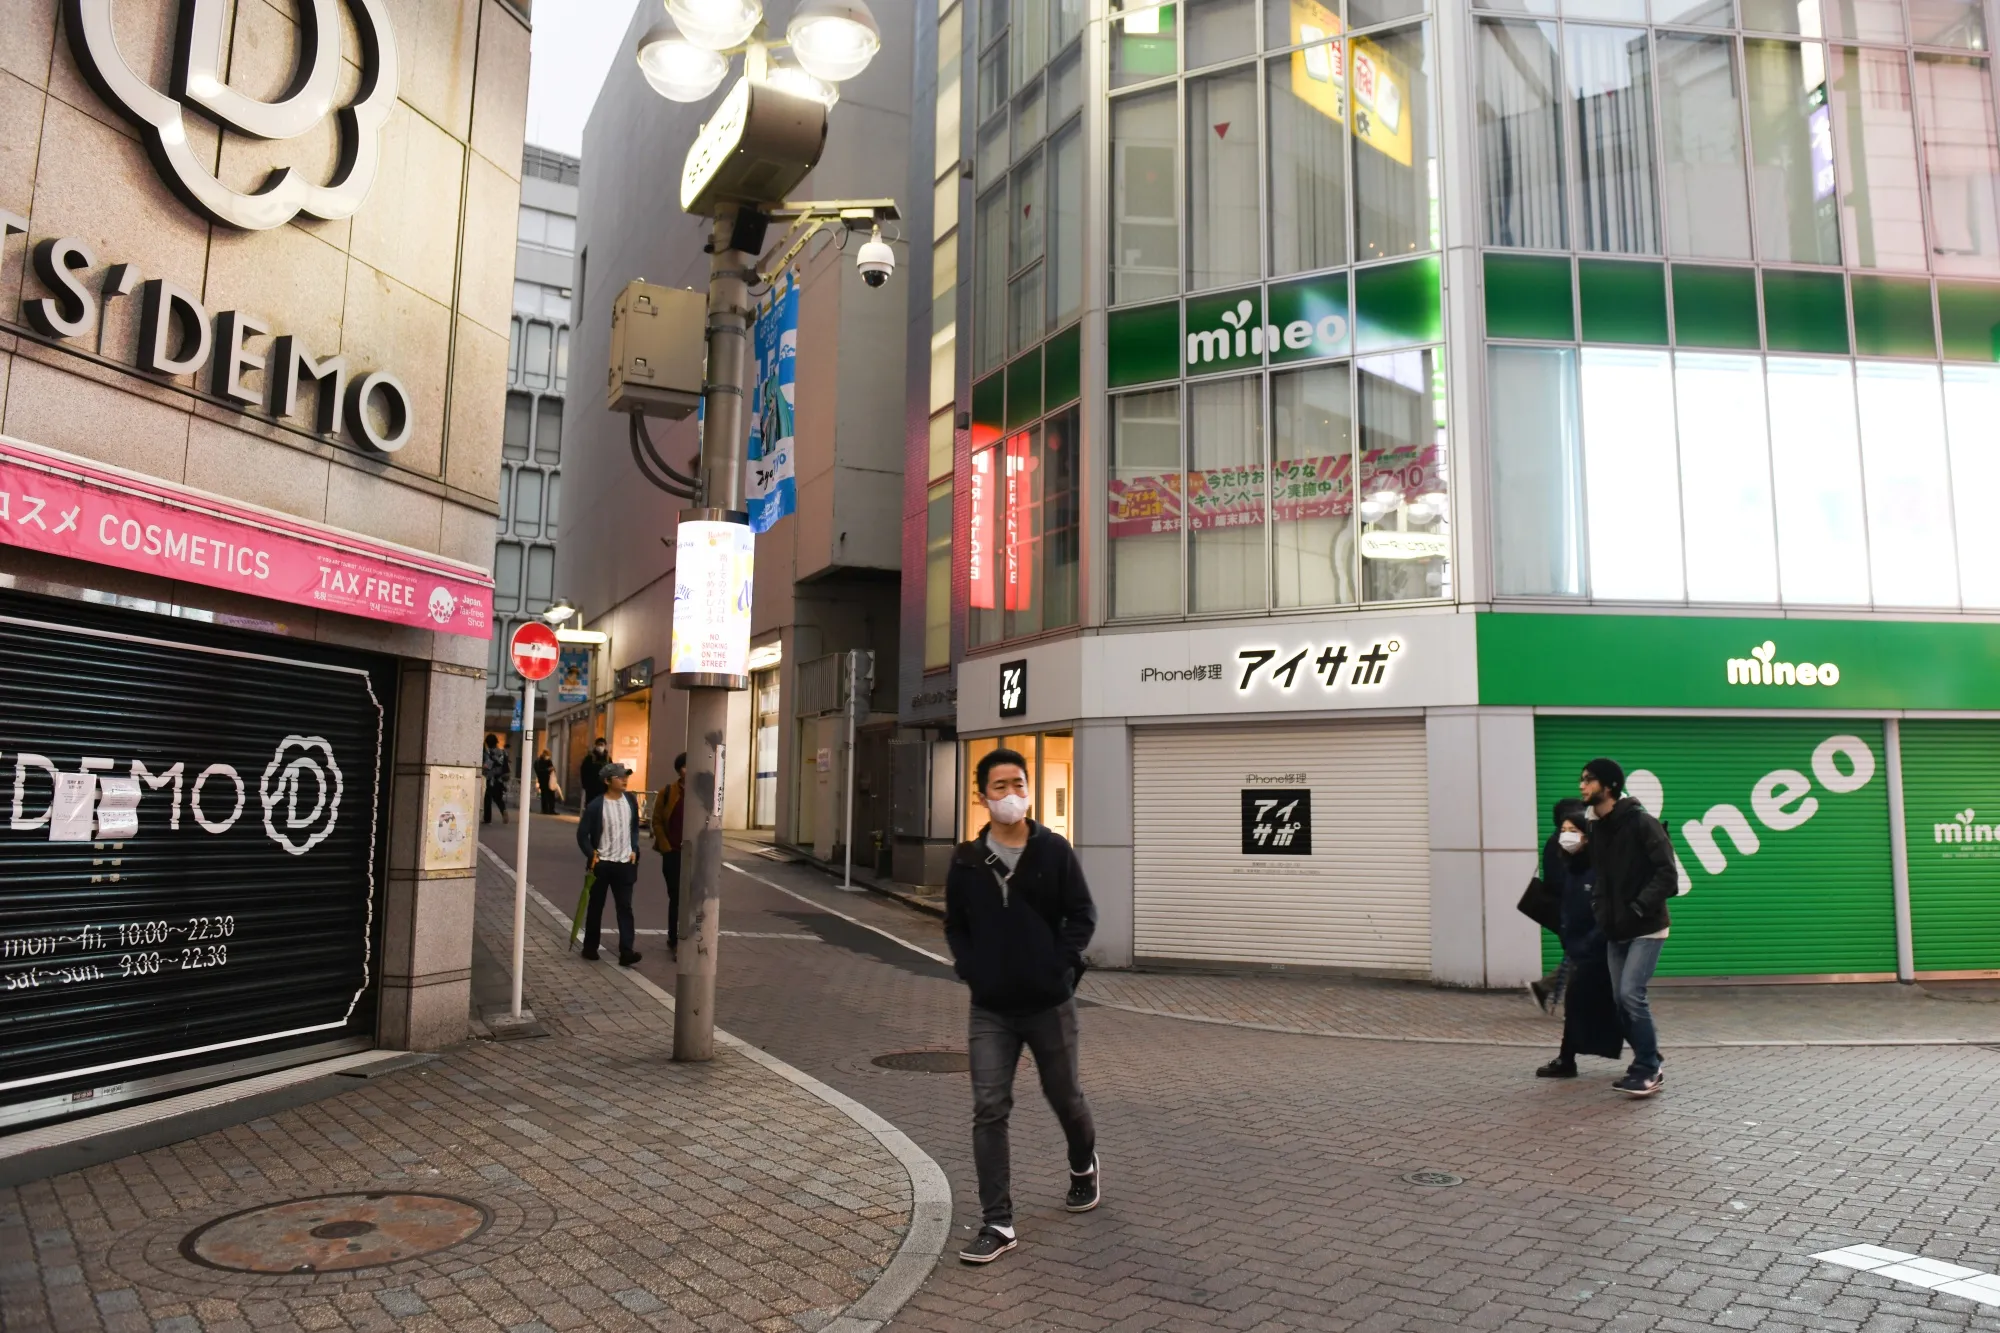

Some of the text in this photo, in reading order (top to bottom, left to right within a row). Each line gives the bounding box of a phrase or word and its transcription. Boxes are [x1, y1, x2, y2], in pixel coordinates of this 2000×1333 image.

[1187, 300, 1347, 364] mineo
[99, 514, 270, 579] COSMETICS
[319, 566, 360, 596] TAX
[365, 577, 415, 607] FREE
[462, 594, 483, 608] Japan.
[459, 605, 485, 619] Tax-free
[467, 617, 485, 629] Shop
[701, 642, 729, 650] SMOKING
[709, 633, 720, 641] NO
[701, 651, 726, 659] ON THE
[701, 660, 728, 668] STREET
[1727, 640, 1840, 686] mineo
[1141, 640, 1400, 690] iPhone修理 アイサポ
[1003, 668, 1021, 690] アイ
[1246, 773, 1307, 784] iPhone修理
[1254, 799, 1300, 822] アイ
[1252, 822, 1302, 846] サポ
